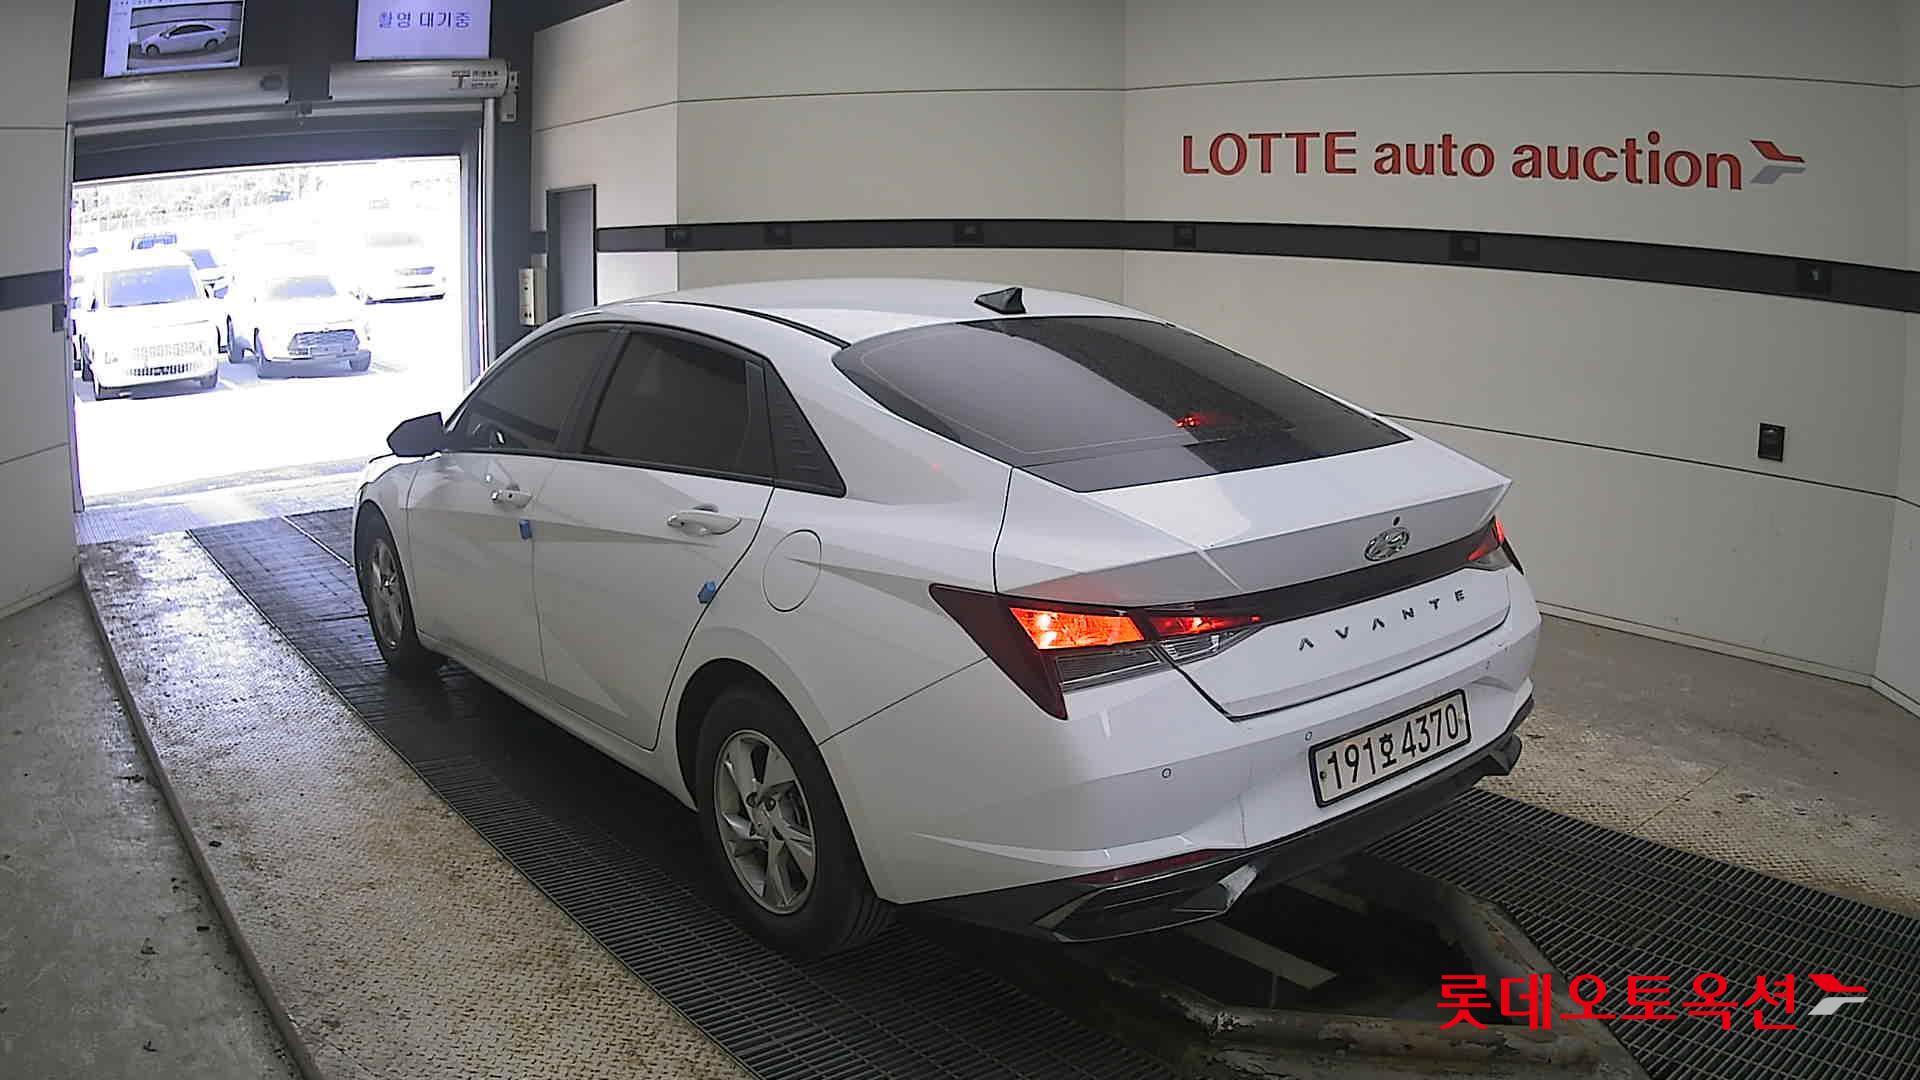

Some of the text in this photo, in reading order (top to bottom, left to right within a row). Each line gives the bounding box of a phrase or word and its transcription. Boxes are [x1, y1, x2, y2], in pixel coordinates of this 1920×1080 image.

[419, 11, 471, 29] 대기중
[1182, 131, 1743, 190] LOTTE auto auction
[1299, 588, 1466, 652] AVANTE
